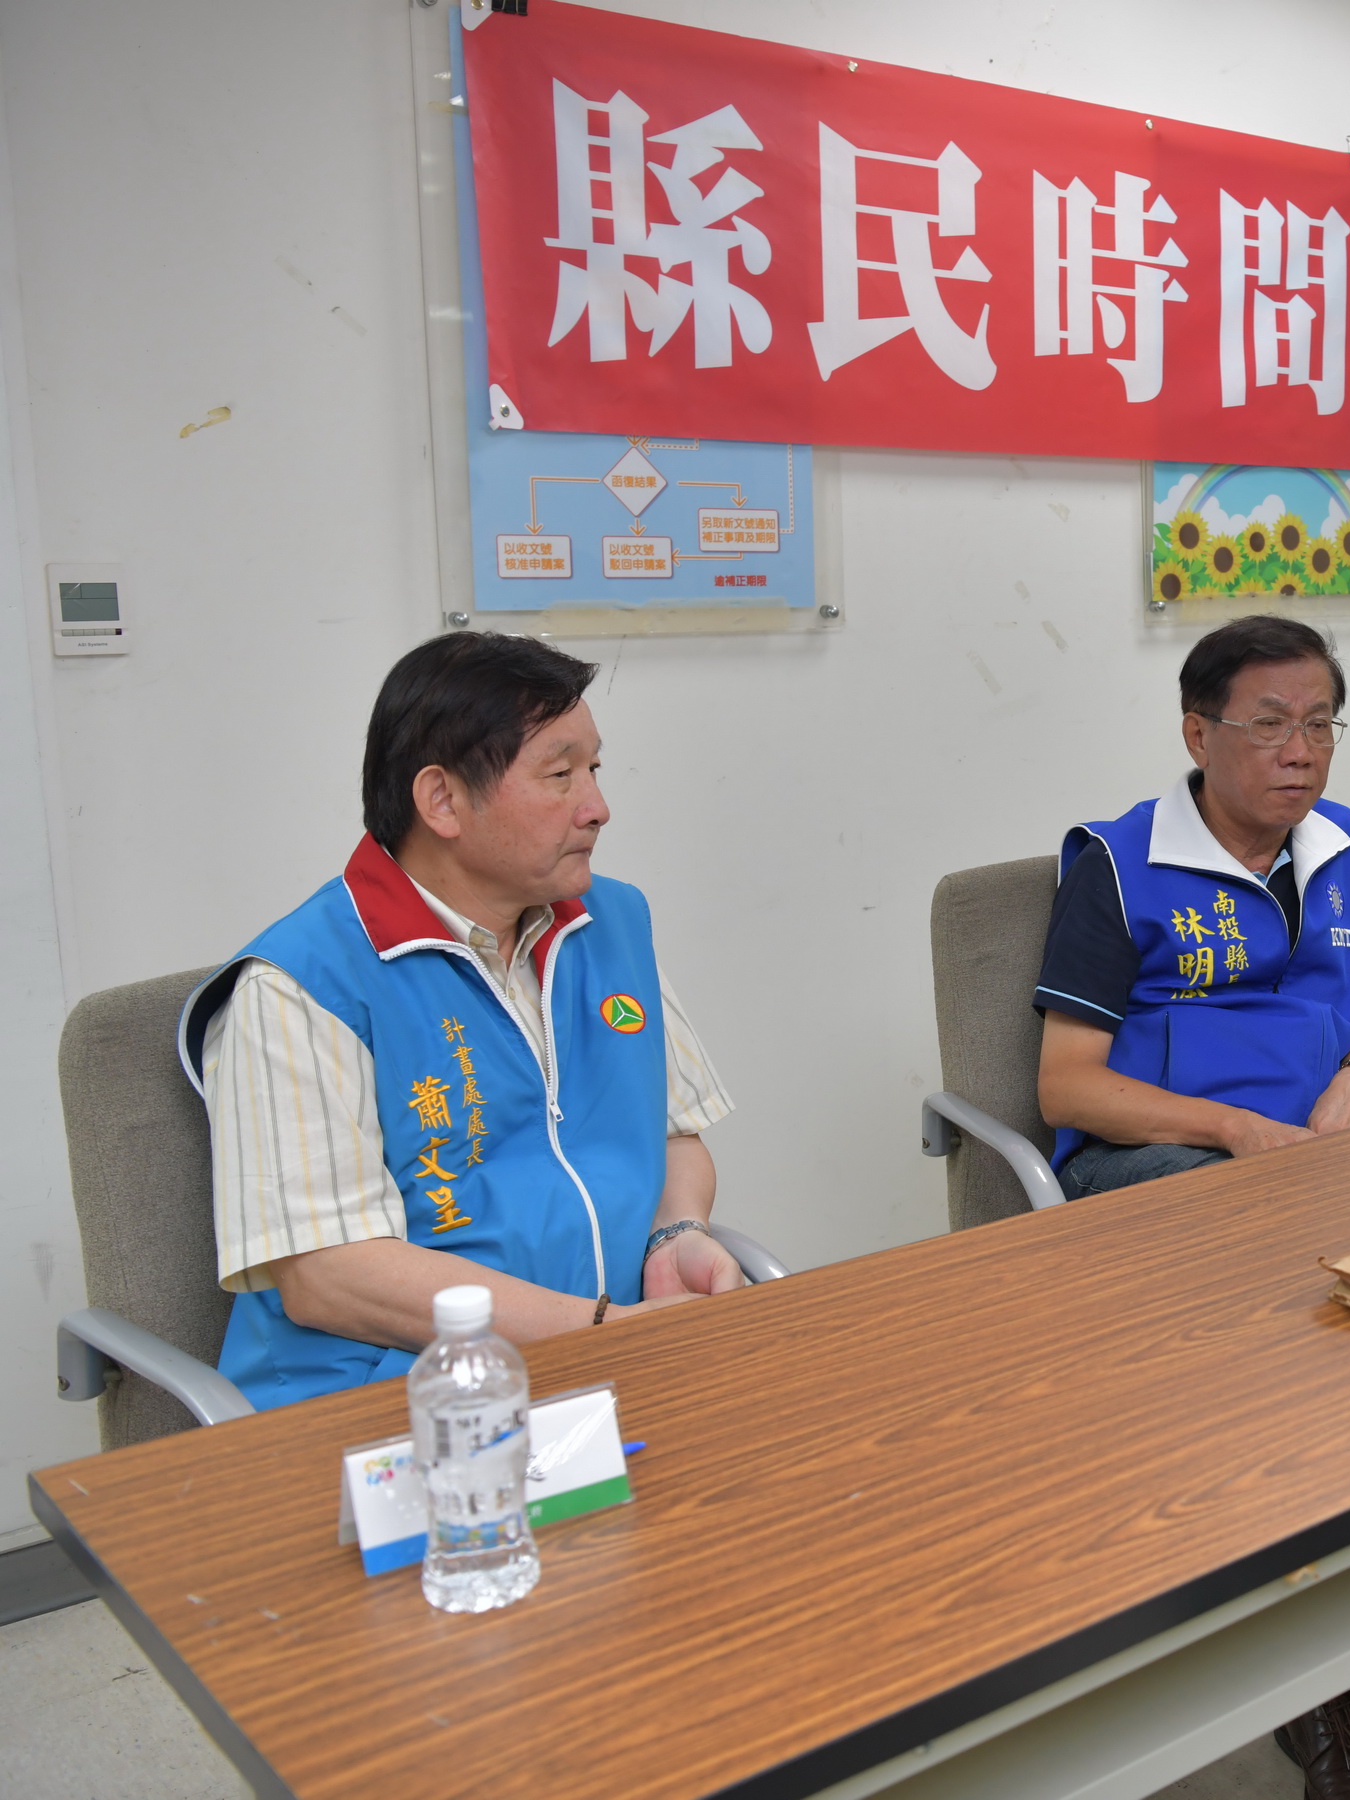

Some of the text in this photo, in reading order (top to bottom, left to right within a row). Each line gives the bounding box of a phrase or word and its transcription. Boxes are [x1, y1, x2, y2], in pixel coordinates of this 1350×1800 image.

[543, 77, 1350, 416] 縣民時間
[702, 517, 776, 531] 另取新文號通知
[702, 531, 776, 545] 補正事項及期限
[504, 542, 552, 556] 以收文號
[609, 544, 655, 557] 以收文號
[505, 557, 565, 571] 核准申請案
[609, 558, 666, 572] 駁回申請案
[714, 575, 767, 588] 逾補正期限
[441, 1017, 489, 1168] 計畫處處長
[408, 1075, 472, 1234] 蕭文呈
